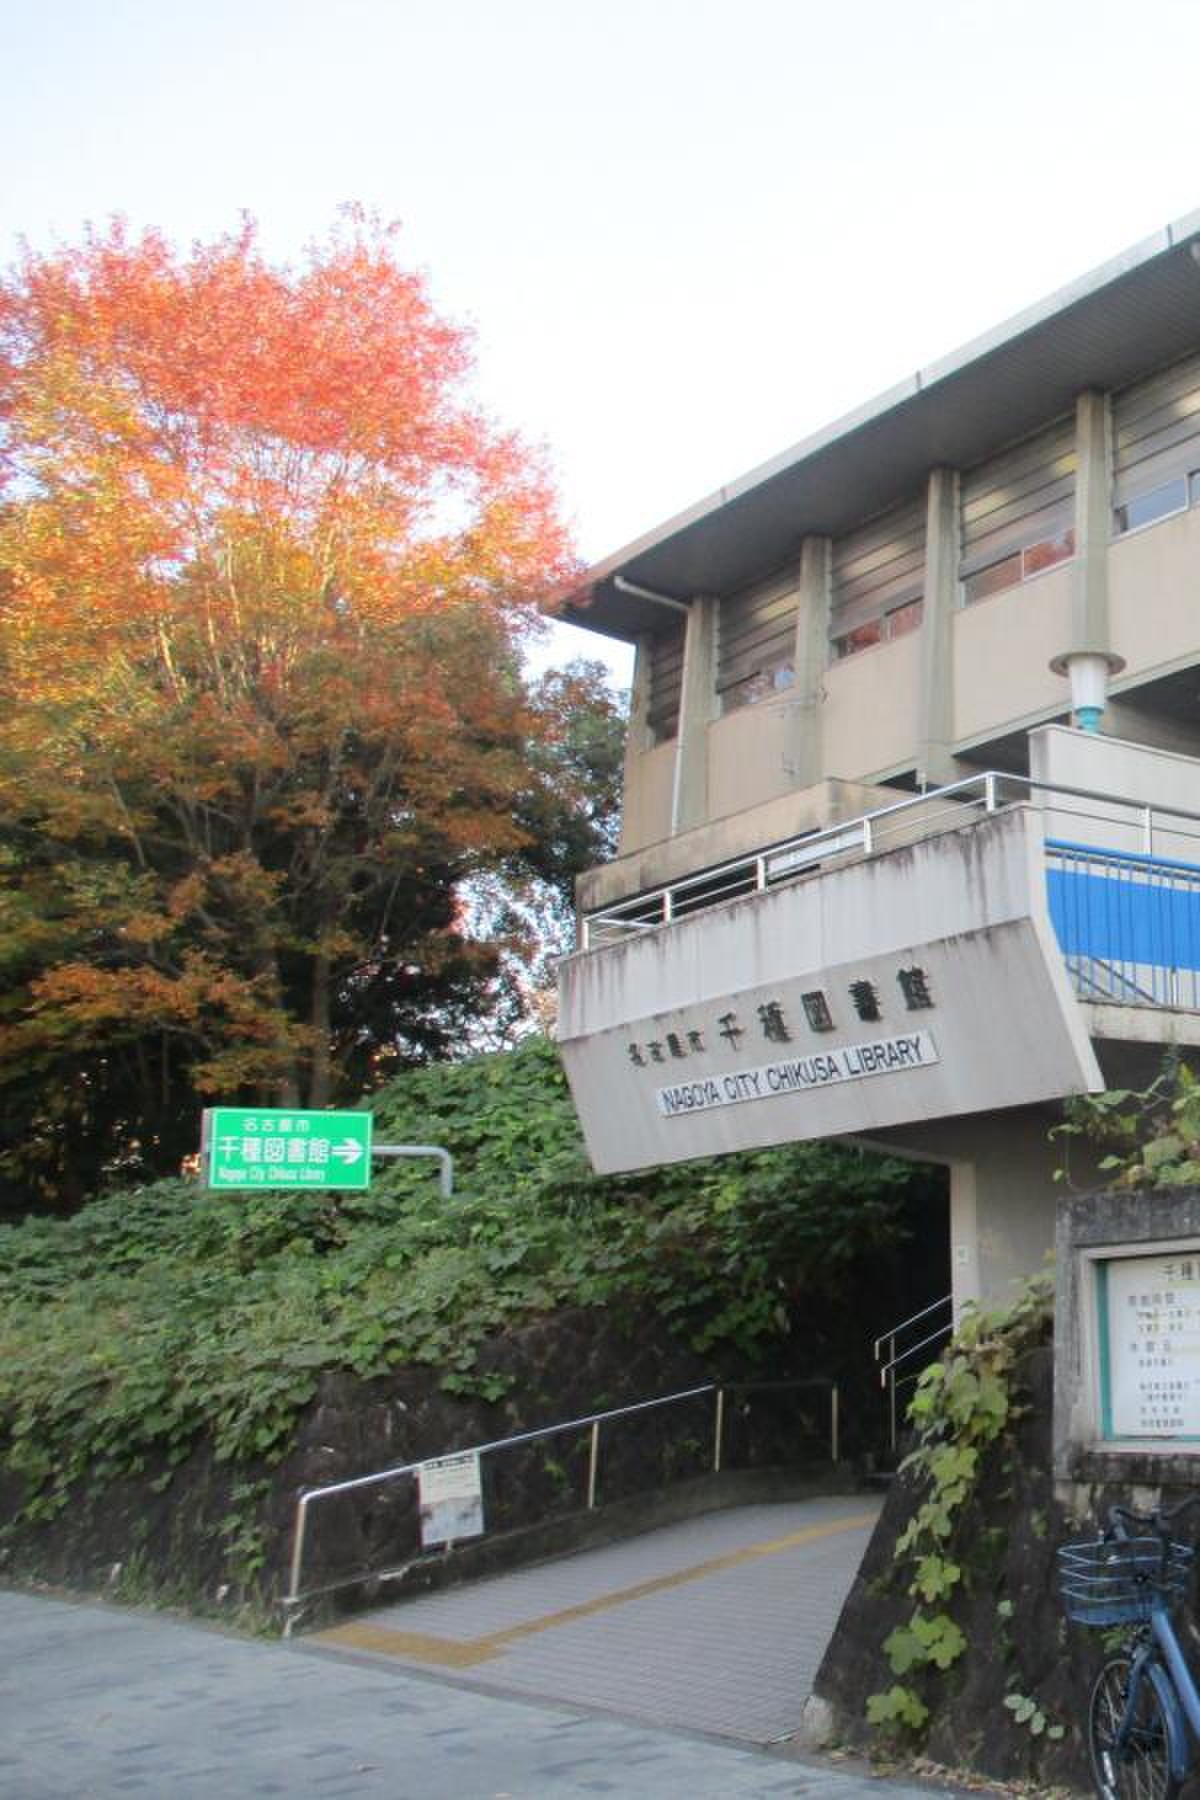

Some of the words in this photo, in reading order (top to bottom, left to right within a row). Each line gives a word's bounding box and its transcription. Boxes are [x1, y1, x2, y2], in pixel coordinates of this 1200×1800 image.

[662, 1080, 720, 1113] NAGOYA
[723, 1071, 762, 1100] CITY
[767, 1055, 840, 1091] CHIKUSA
[843, 1036, 924, 1075] LIBRARY
[217, 1135, 330, 1164] 千種図書館
